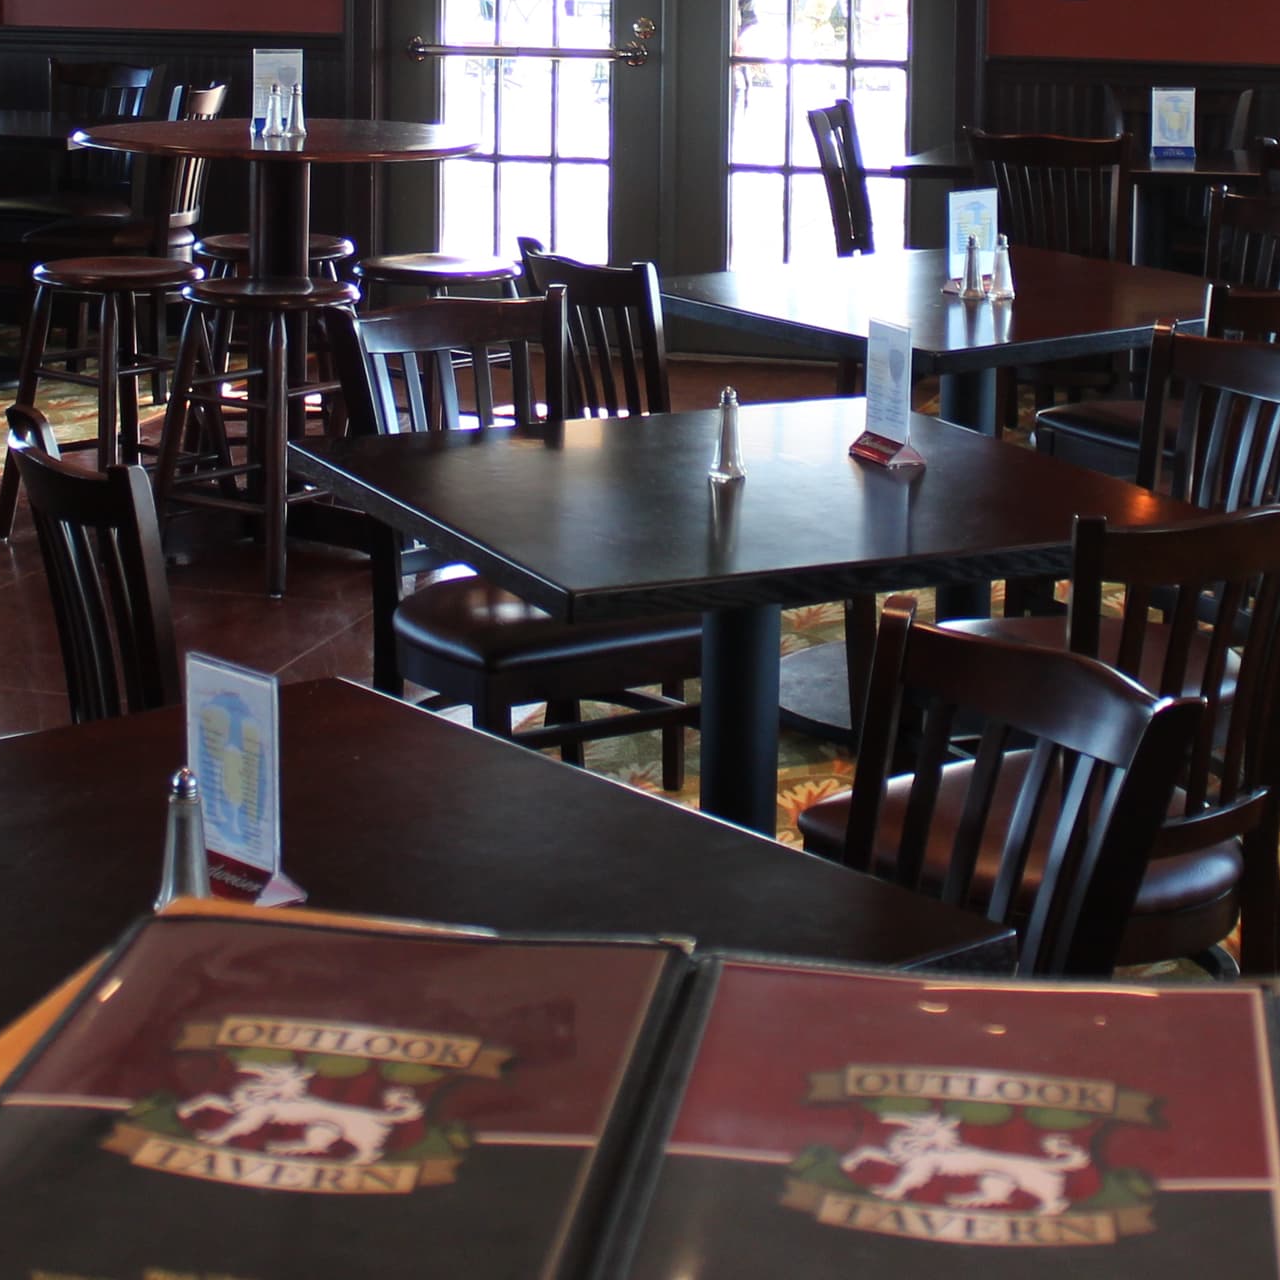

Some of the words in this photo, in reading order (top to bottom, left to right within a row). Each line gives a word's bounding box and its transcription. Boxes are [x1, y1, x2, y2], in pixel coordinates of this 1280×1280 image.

[228, 1023, 468, 1064] OUTLOOK
[855, 1071, 1108, 1108] OUTLOOK
[149, 1143, 405, 1190] TAVERN
[831, 1200, 1102, 1242] TAVERN
